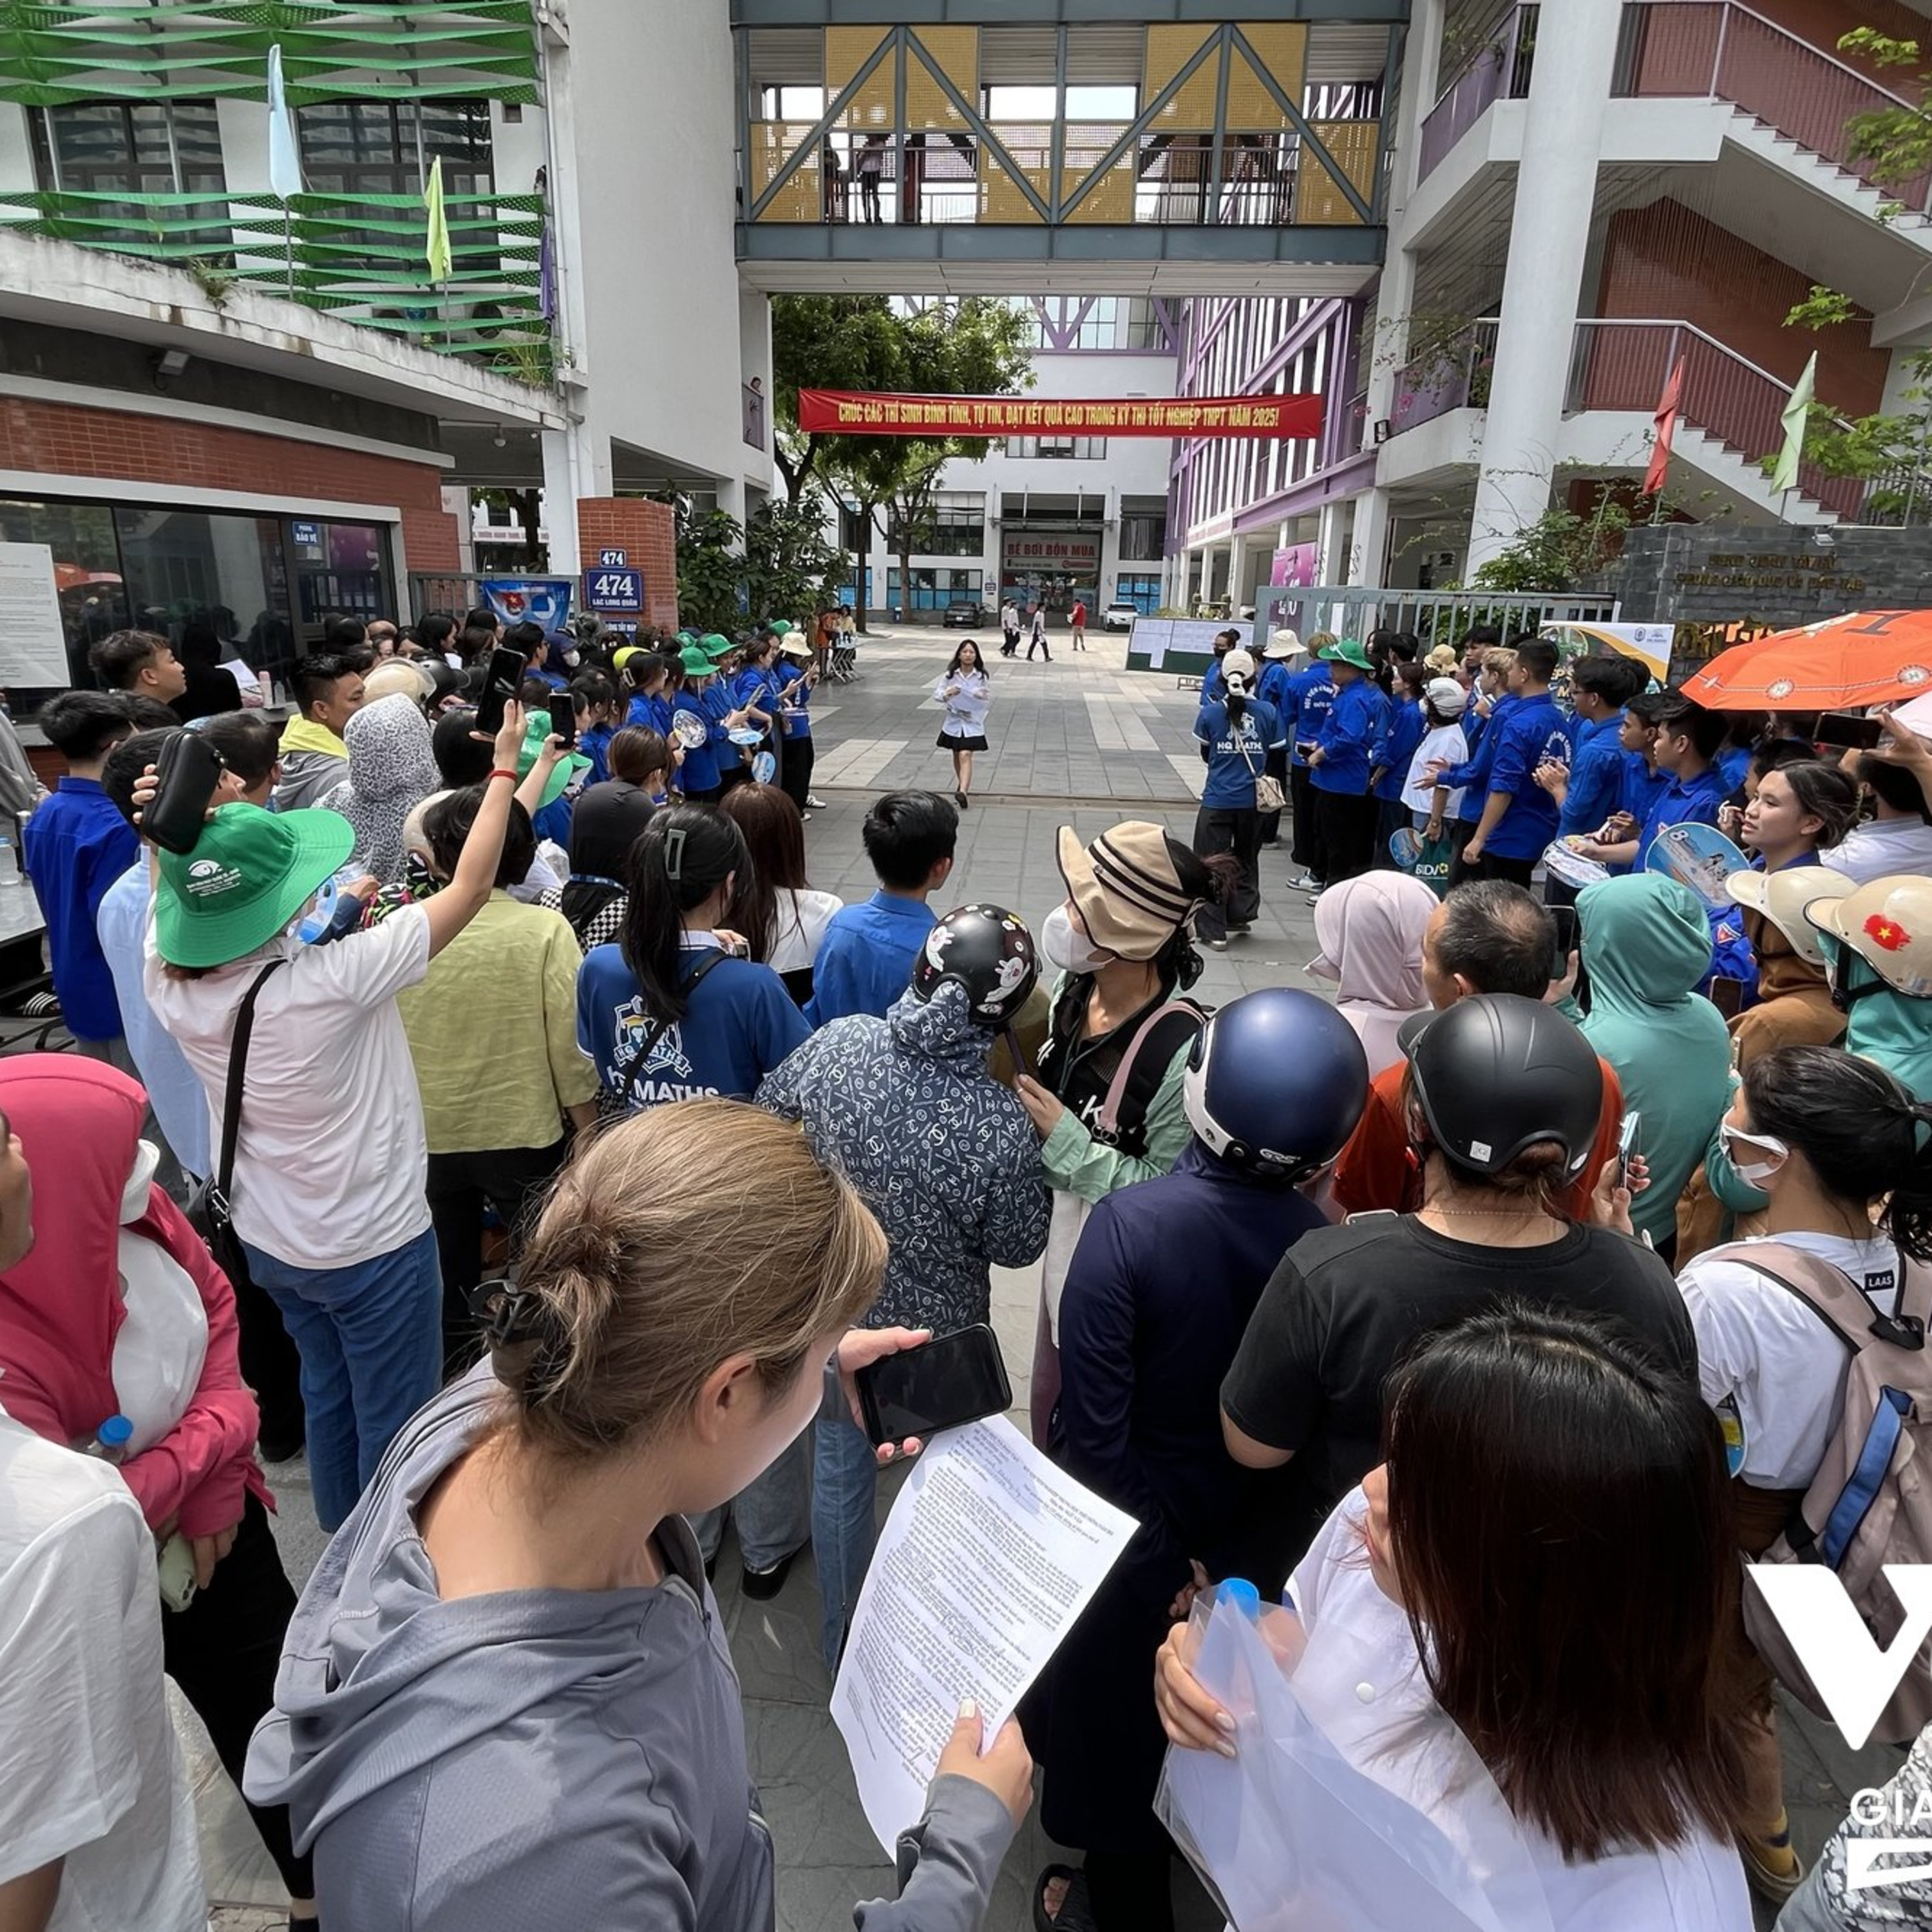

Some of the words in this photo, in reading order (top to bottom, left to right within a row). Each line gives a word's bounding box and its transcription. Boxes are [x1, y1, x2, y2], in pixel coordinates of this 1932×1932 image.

[838, 399, 863, 422] CHÚC
[864, 399, 883, 422] CÁC
[884, 400, 899, 423] THÍ
[900, 404, 923, 424] SINH
[923, 400, 947, 424] BÌNH
[973, 404, 987, 428] TỰ
[987, 405, 1004, 427] TIN,
[1006, 405, 1025, 429] ĐẠT
[1025, 401, 1042, 425] KẾT
[1044, 401, 1063, 427] QUẢ
[1065, 406, 1084, 426] CAO
[1085, 406, 1115, 426] TRONG
[1117, 402, 1130, 426] KỲ
[1132, 406, 1146, 426] THI
[1148, 401, 1165, 426] TỐT
[1166, 402, 1202, 431] NGHIỆP
[1203, 406, 1227, 427] THPT
[1227, 403, 1251, 427] NĂM
[1253, 407, 1280, 427] 2025!
[602, 551, 623, 565] 474
[594, 574, 634, 596] 474
[1869, 1275, 1893, 1287] LAAS
